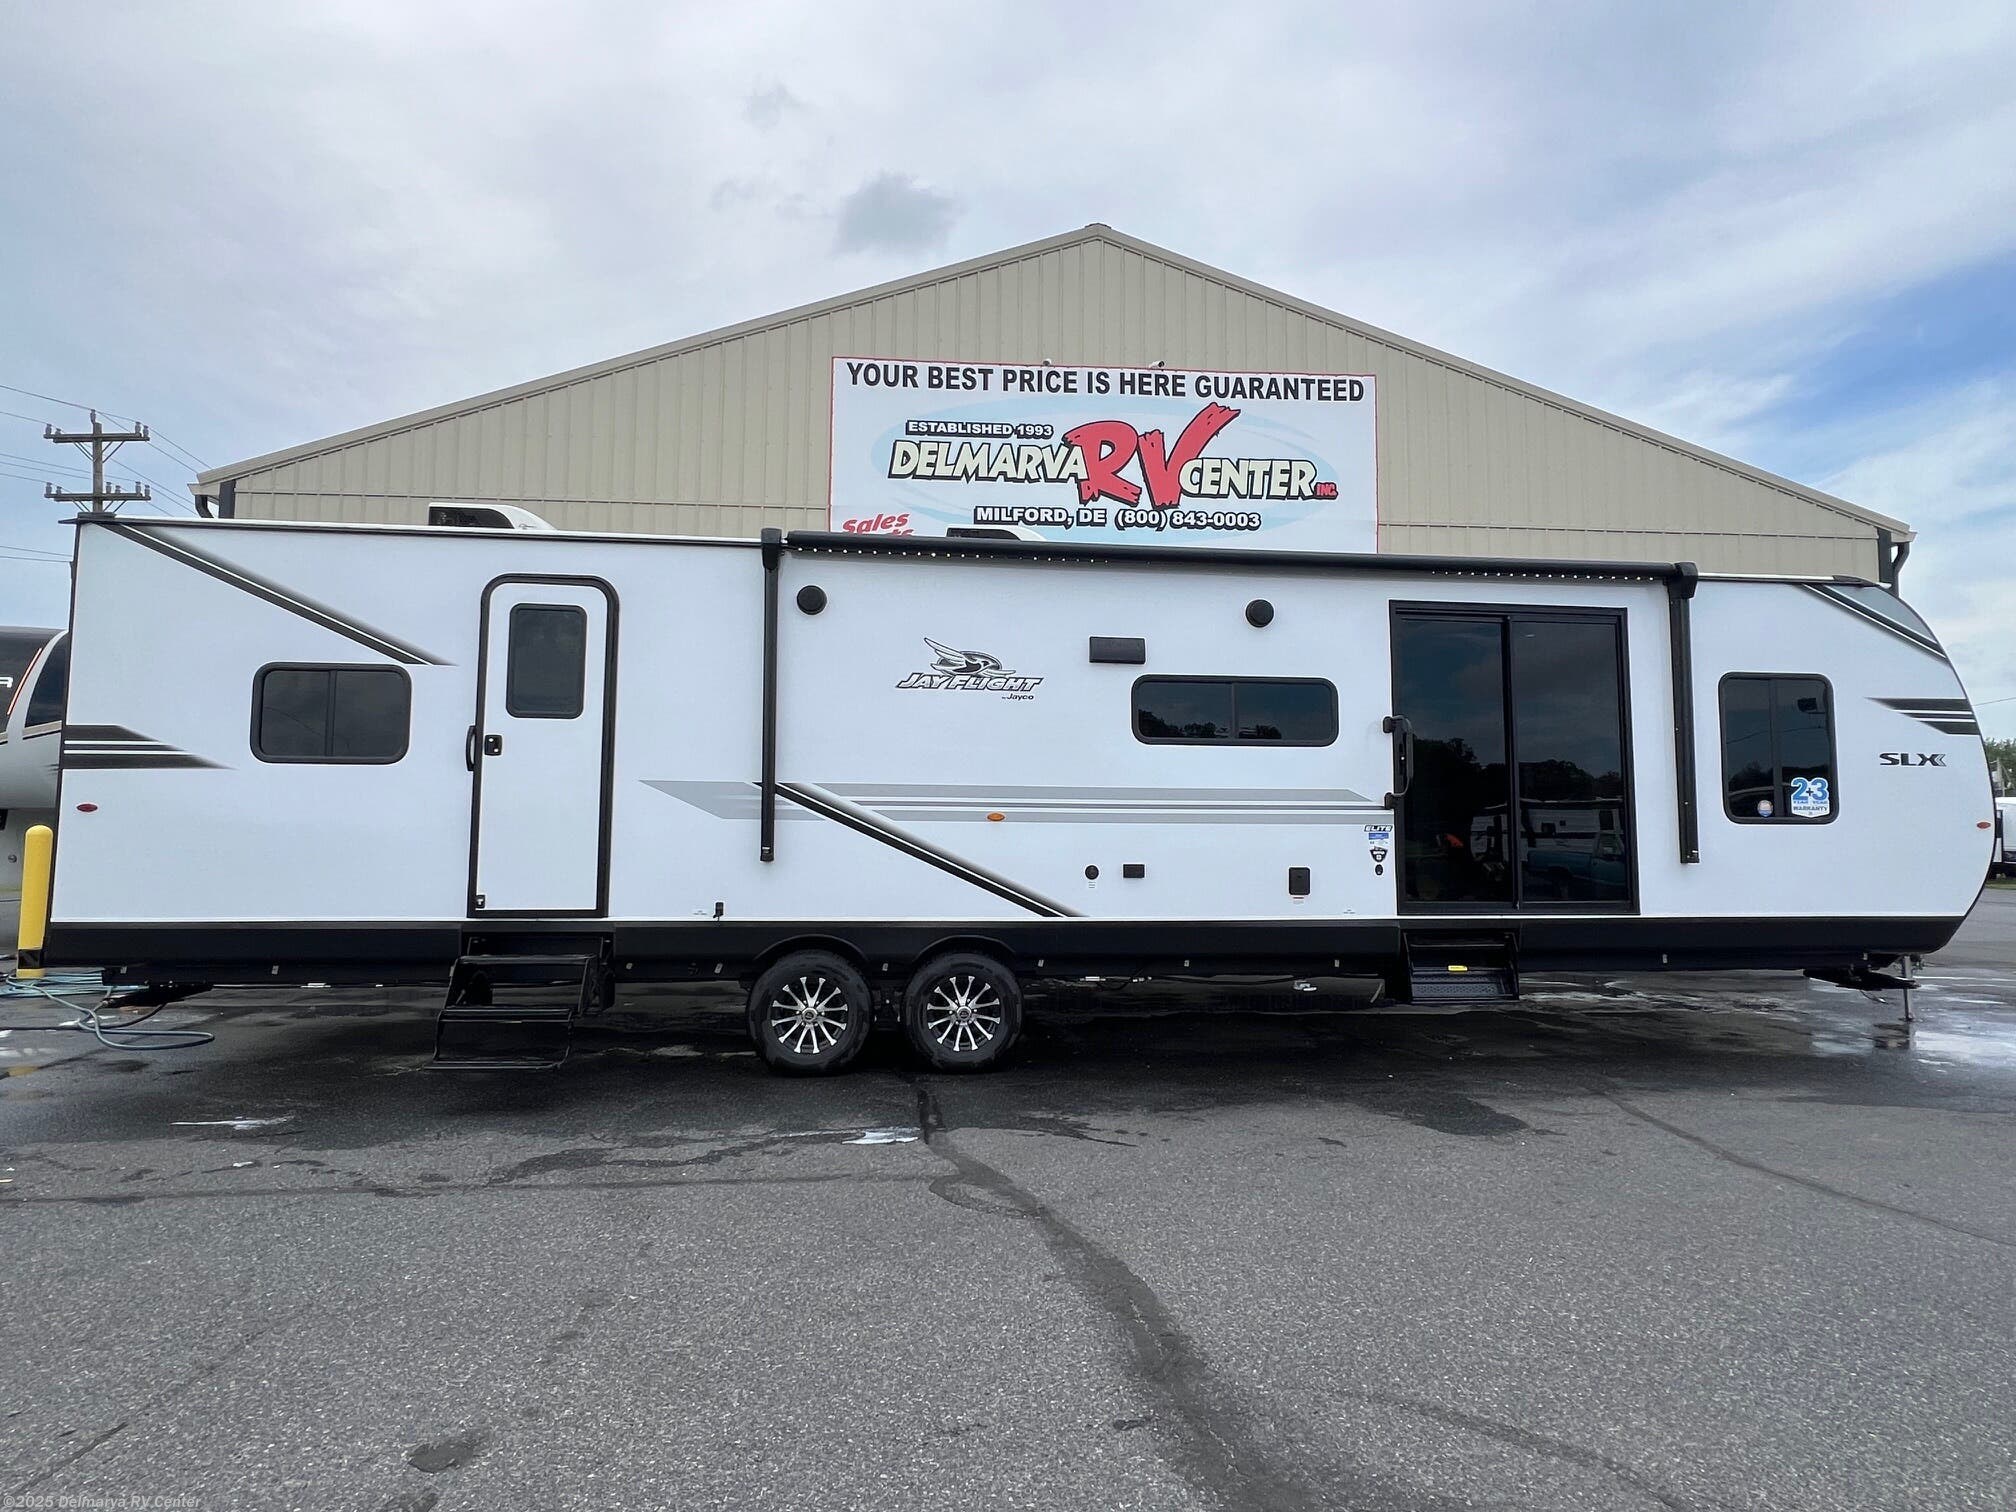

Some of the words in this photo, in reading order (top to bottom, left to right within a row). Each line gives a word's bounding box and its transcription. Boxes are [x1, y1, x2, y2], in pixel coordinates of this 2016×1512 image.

[847, 362, 919, 388] YOUR
[928, 366, 994, 391] BEST
[1002, 368, 1078, 393] PRICE
[1087, 371, 1111, 394] IS
[1119, 372, 1186, 397] HERE
[1195, 376, 1364, 402] GUARANTEED
[906, 420, 1014, 438] ESTABLISHED
[1015, 424, 1053, 439] 1993
[889, 440, 1089, 483] DELMARVA
[1062, 402, 1240, 509] RV
[1178, 458, 1317, 499] CENTER
[975, 506, 1073, 528] MILFORD,
[1077, 508, 1107, 527] DE
[1115, 509, 1166, 531] (800)
[1170, 511, 1261, 530] 843-0003
[895, 672, 950, 689] JAY
[945, 674, 1044, 691] FLIGHT
[1006, 692, 1034, 701] Jayco
